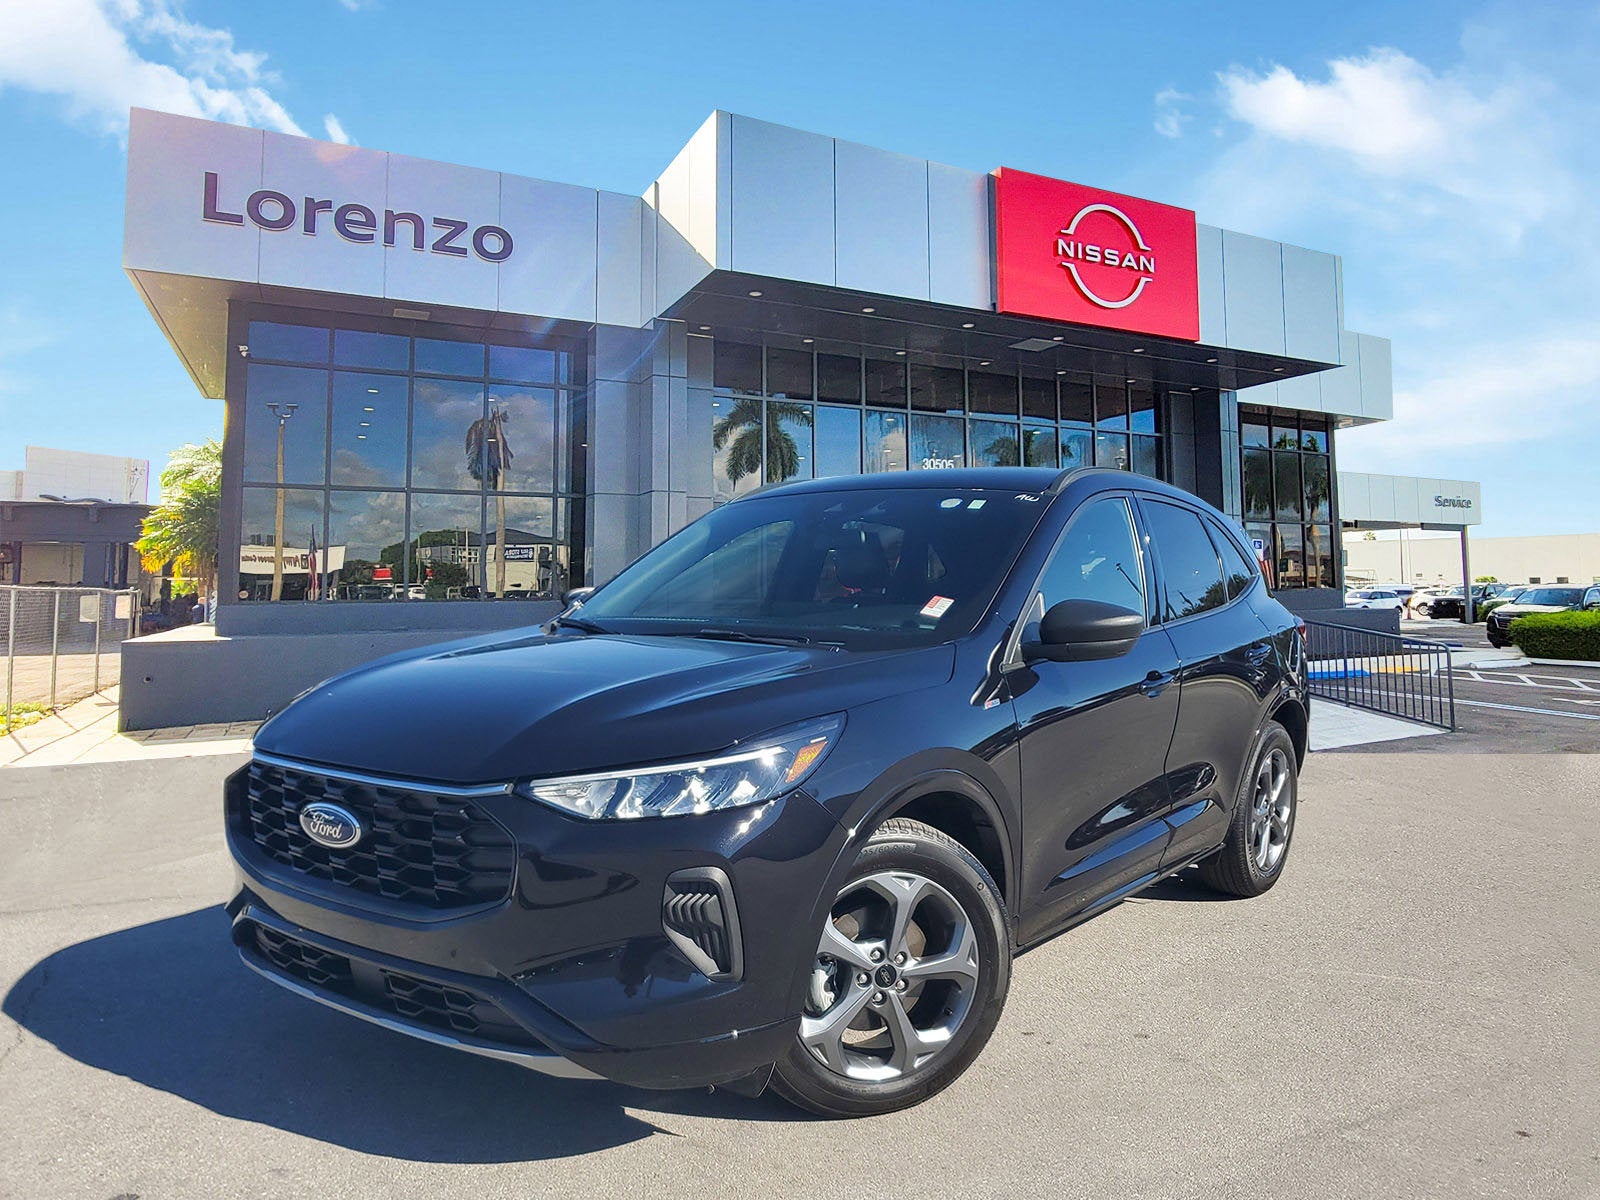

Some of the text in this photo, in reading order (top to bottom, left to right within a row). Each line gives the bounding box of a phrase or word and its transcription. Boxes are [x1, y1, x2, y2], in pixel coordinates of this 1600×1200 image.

[202, 171, 514, 263] Lorenzo
[1057, 238, 1155, 273] NISSAN
[922, 457, 954, 470] 30505
[1434, 495, 1472, 509] Service
[310, 811, 342, 839] Ford
